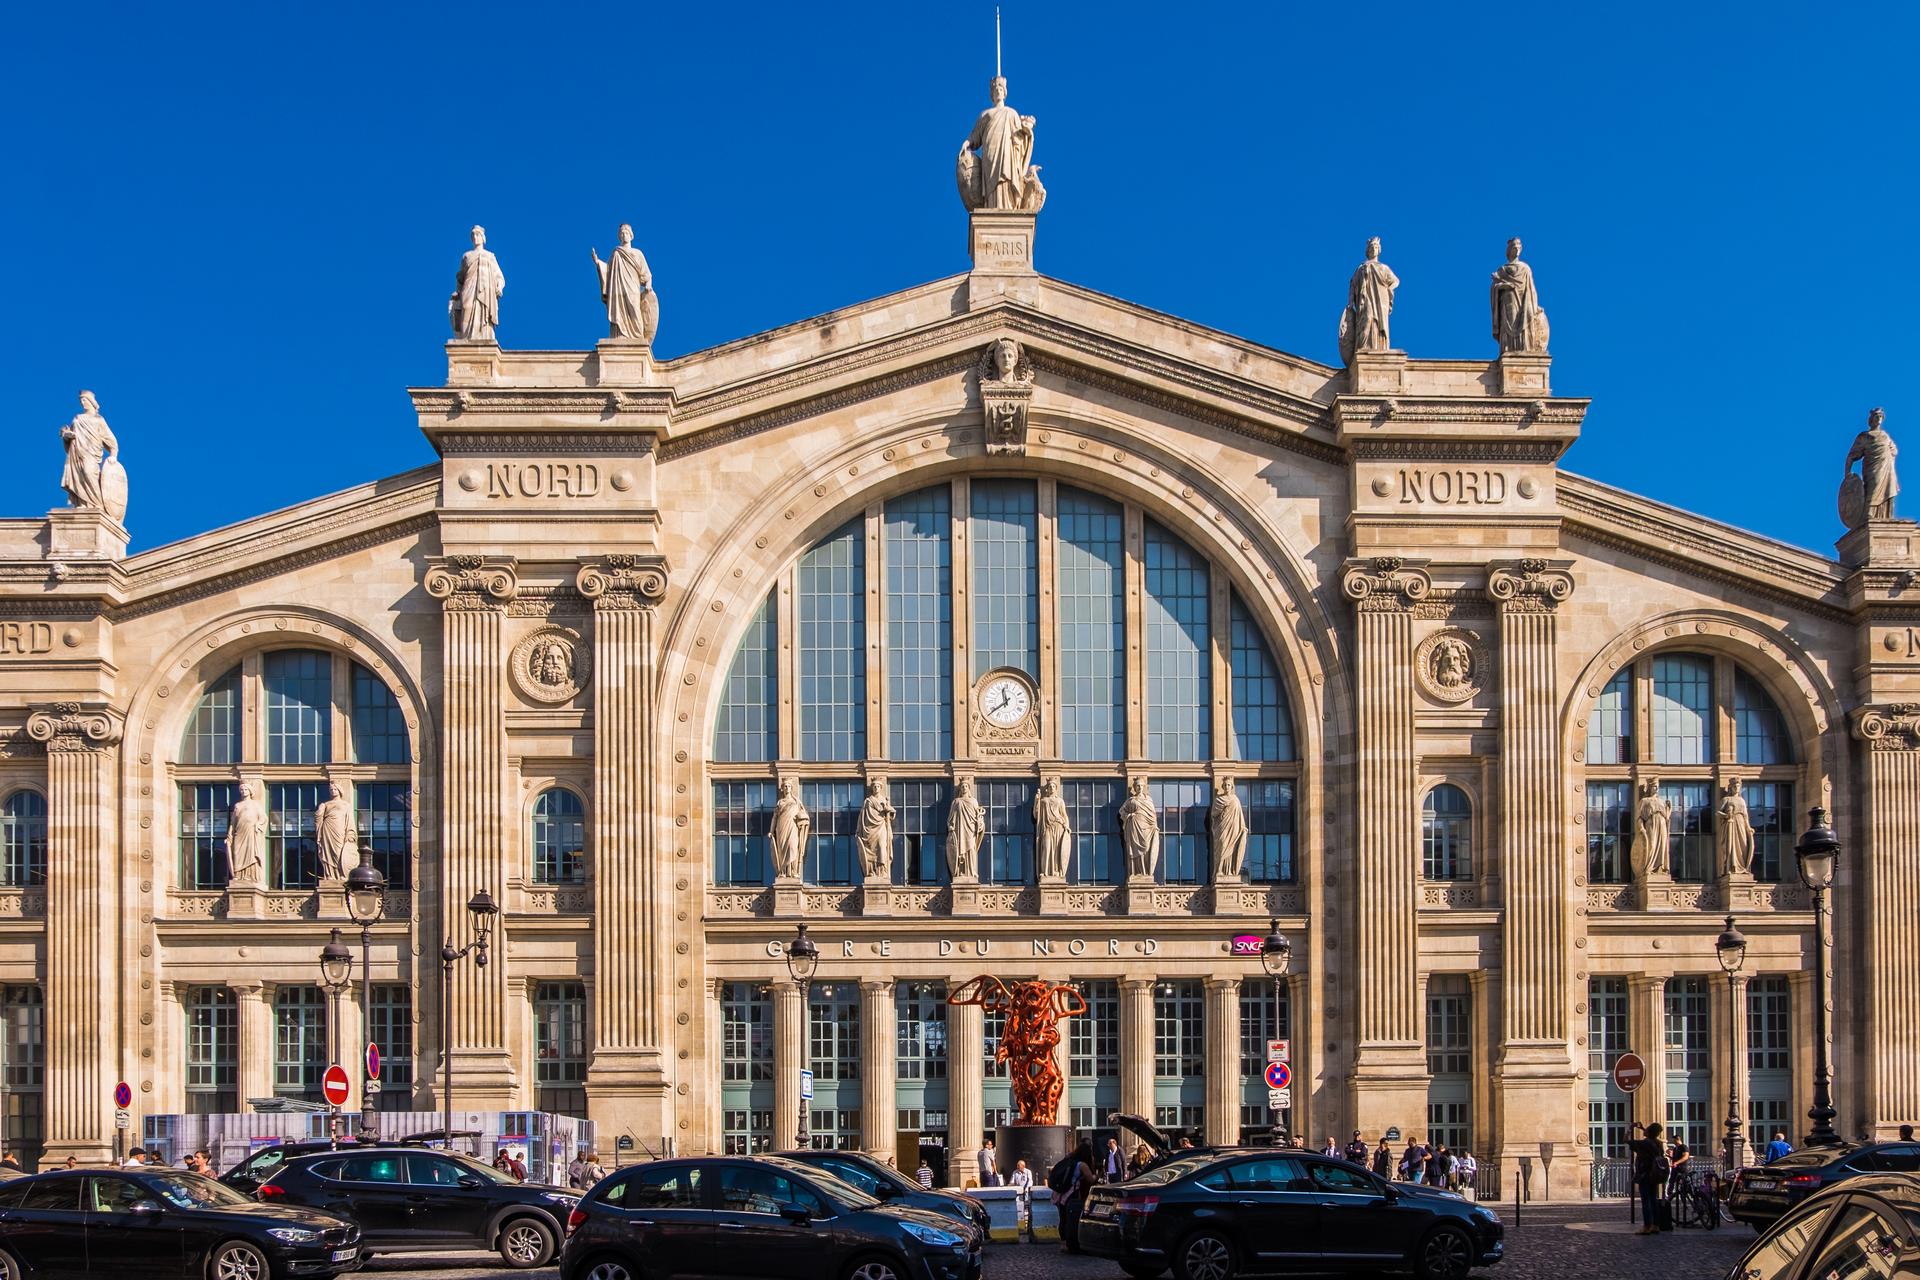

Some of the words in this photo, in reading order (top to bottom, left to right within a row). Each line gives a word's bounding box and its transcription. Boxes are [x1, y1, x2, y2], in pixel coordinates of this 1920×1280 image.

[985, 241, 1023, 256] PARIS
[486, 464, 602, 499] NORD
[1399, 469, 1507, 505] NORD
[766, 940, 891, 957] GRE
[939, 939, 990, 956] DU
[1032, 939, 1158, 956] NORD
